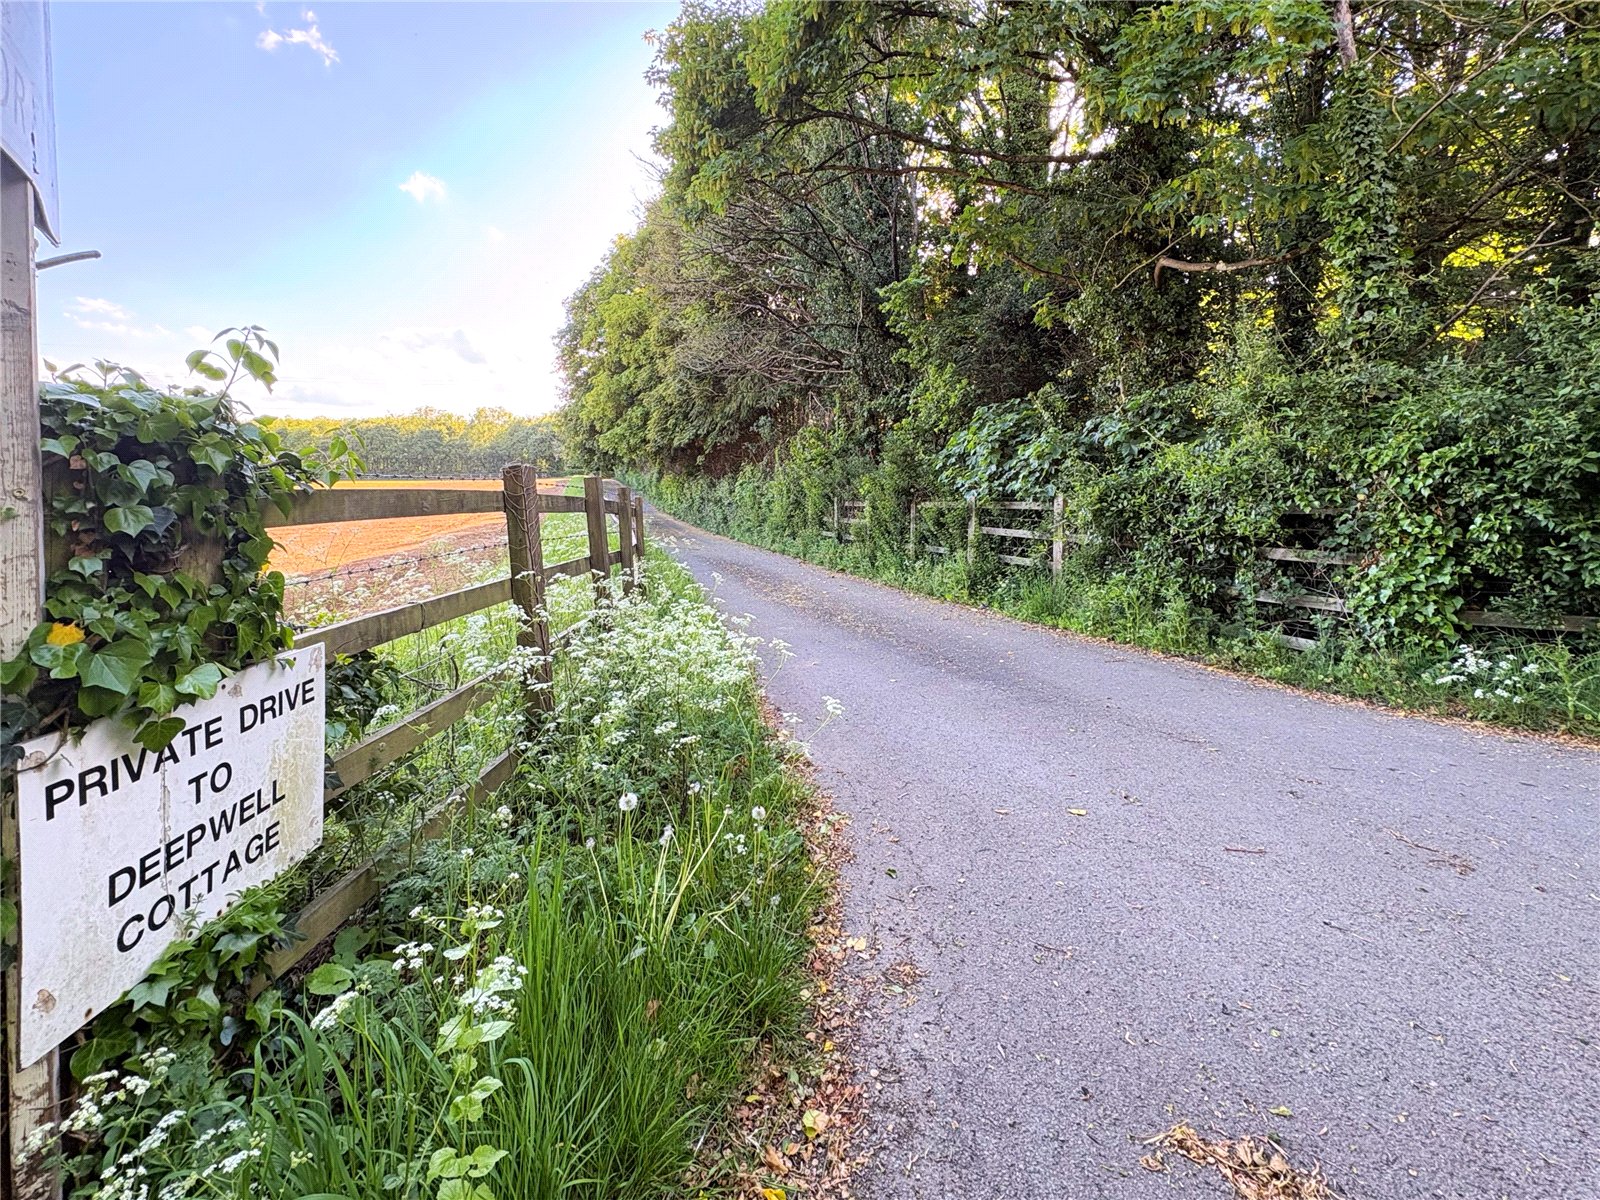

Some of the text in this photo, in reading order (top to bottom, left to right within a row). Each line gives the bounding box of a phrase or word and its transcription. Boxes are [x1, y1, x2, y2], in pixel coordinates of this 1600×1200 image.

[45, 677, 315, 822] PRIVATE DRIVE
[187, 762, 233, 805] TO
[108, 780, 286, 908] DEEPWELL
[116, 820, 281, 953] COTTAGE
